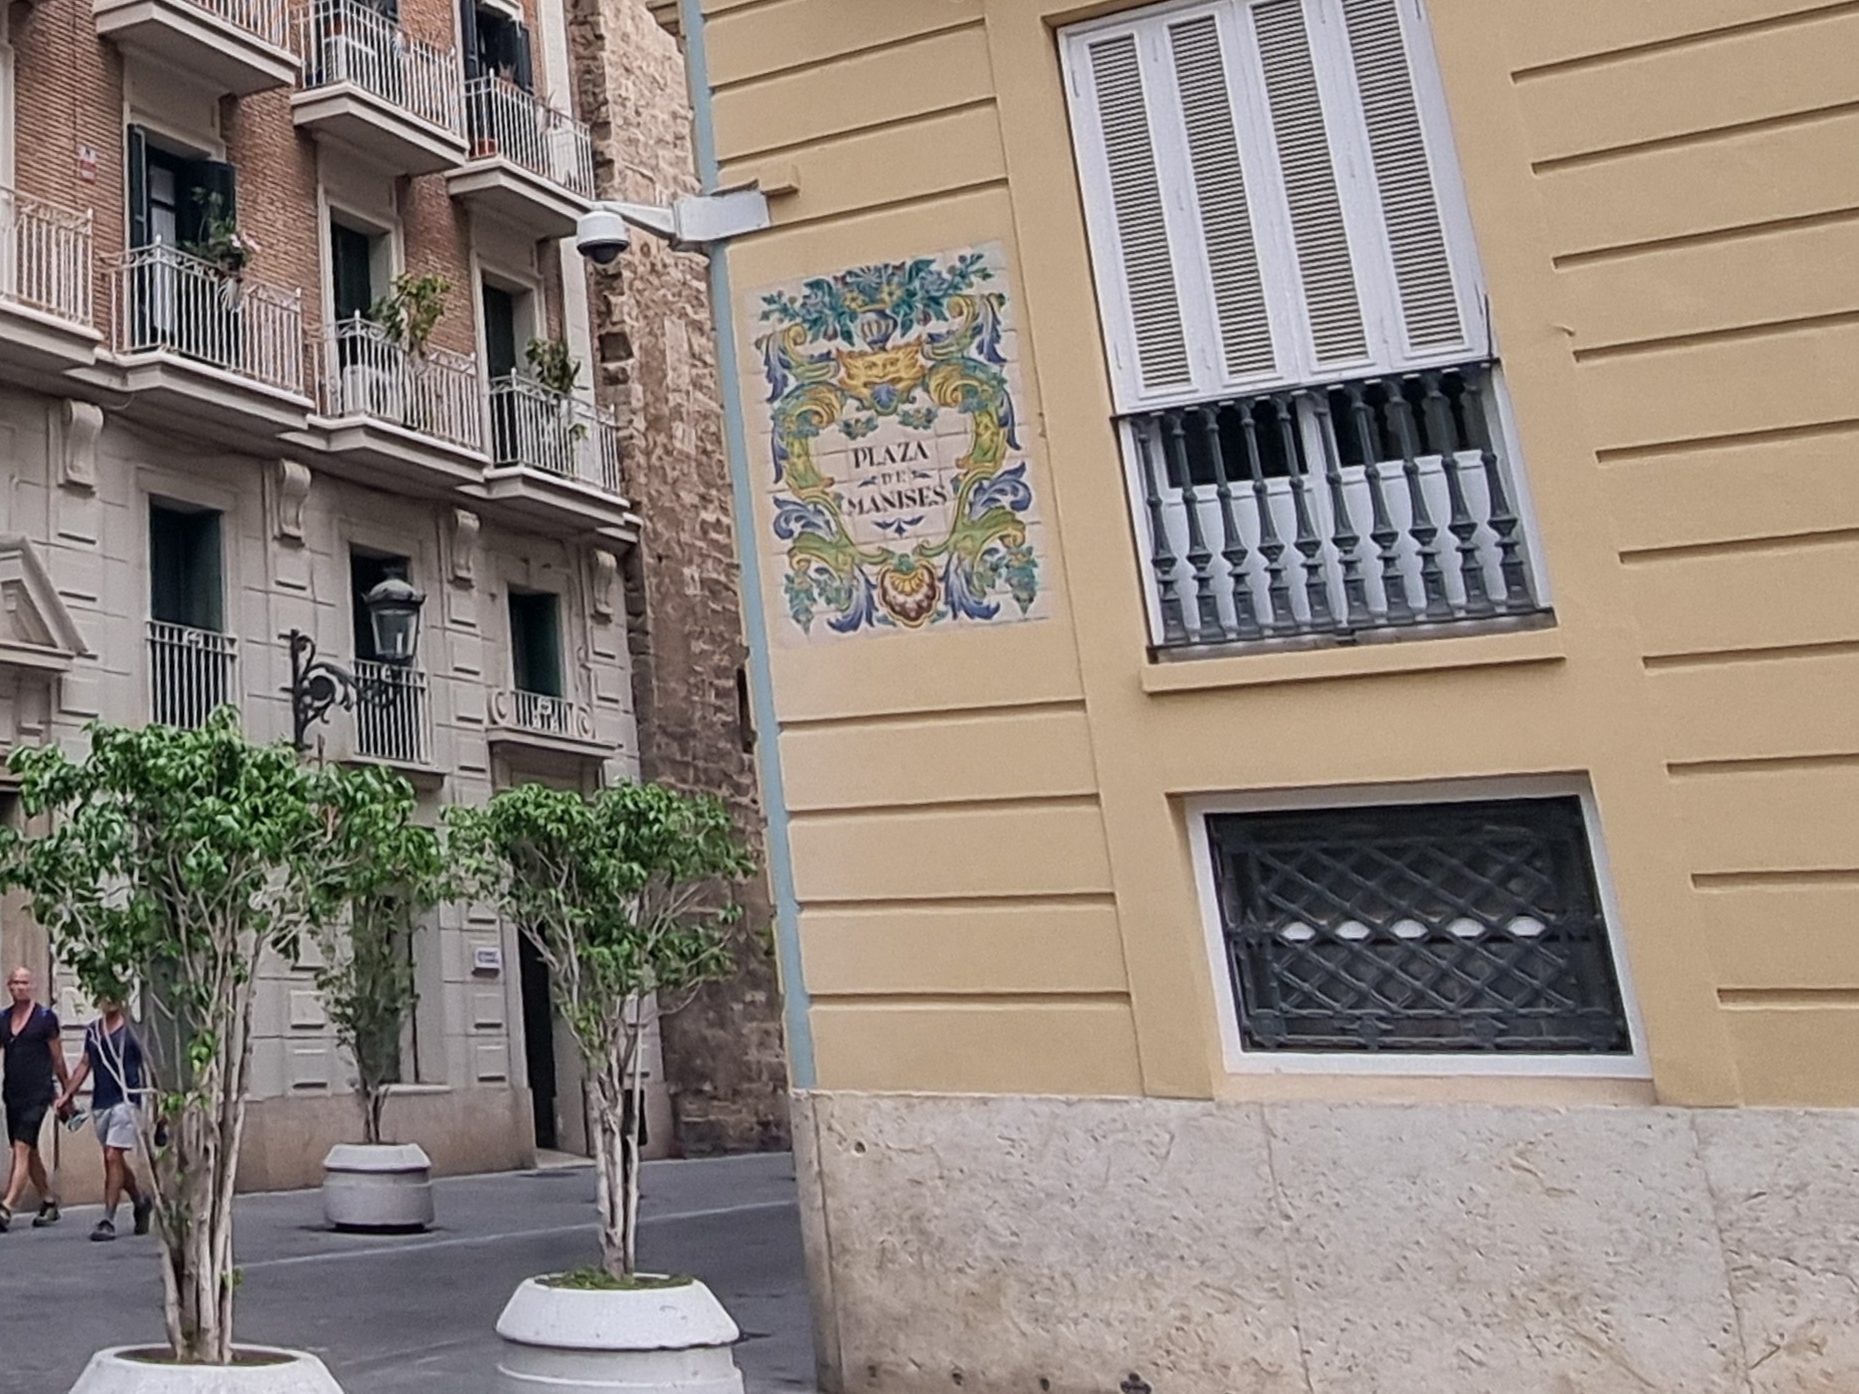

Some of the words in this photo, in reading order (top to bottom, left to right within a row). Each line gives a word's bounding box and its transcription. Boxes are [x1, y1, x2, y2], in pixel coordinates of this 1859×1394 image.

[854, 441, 929, 468] PLAZA
[881, 470, 906, 485] DE
[846, 485, 948, 516] MANISES
